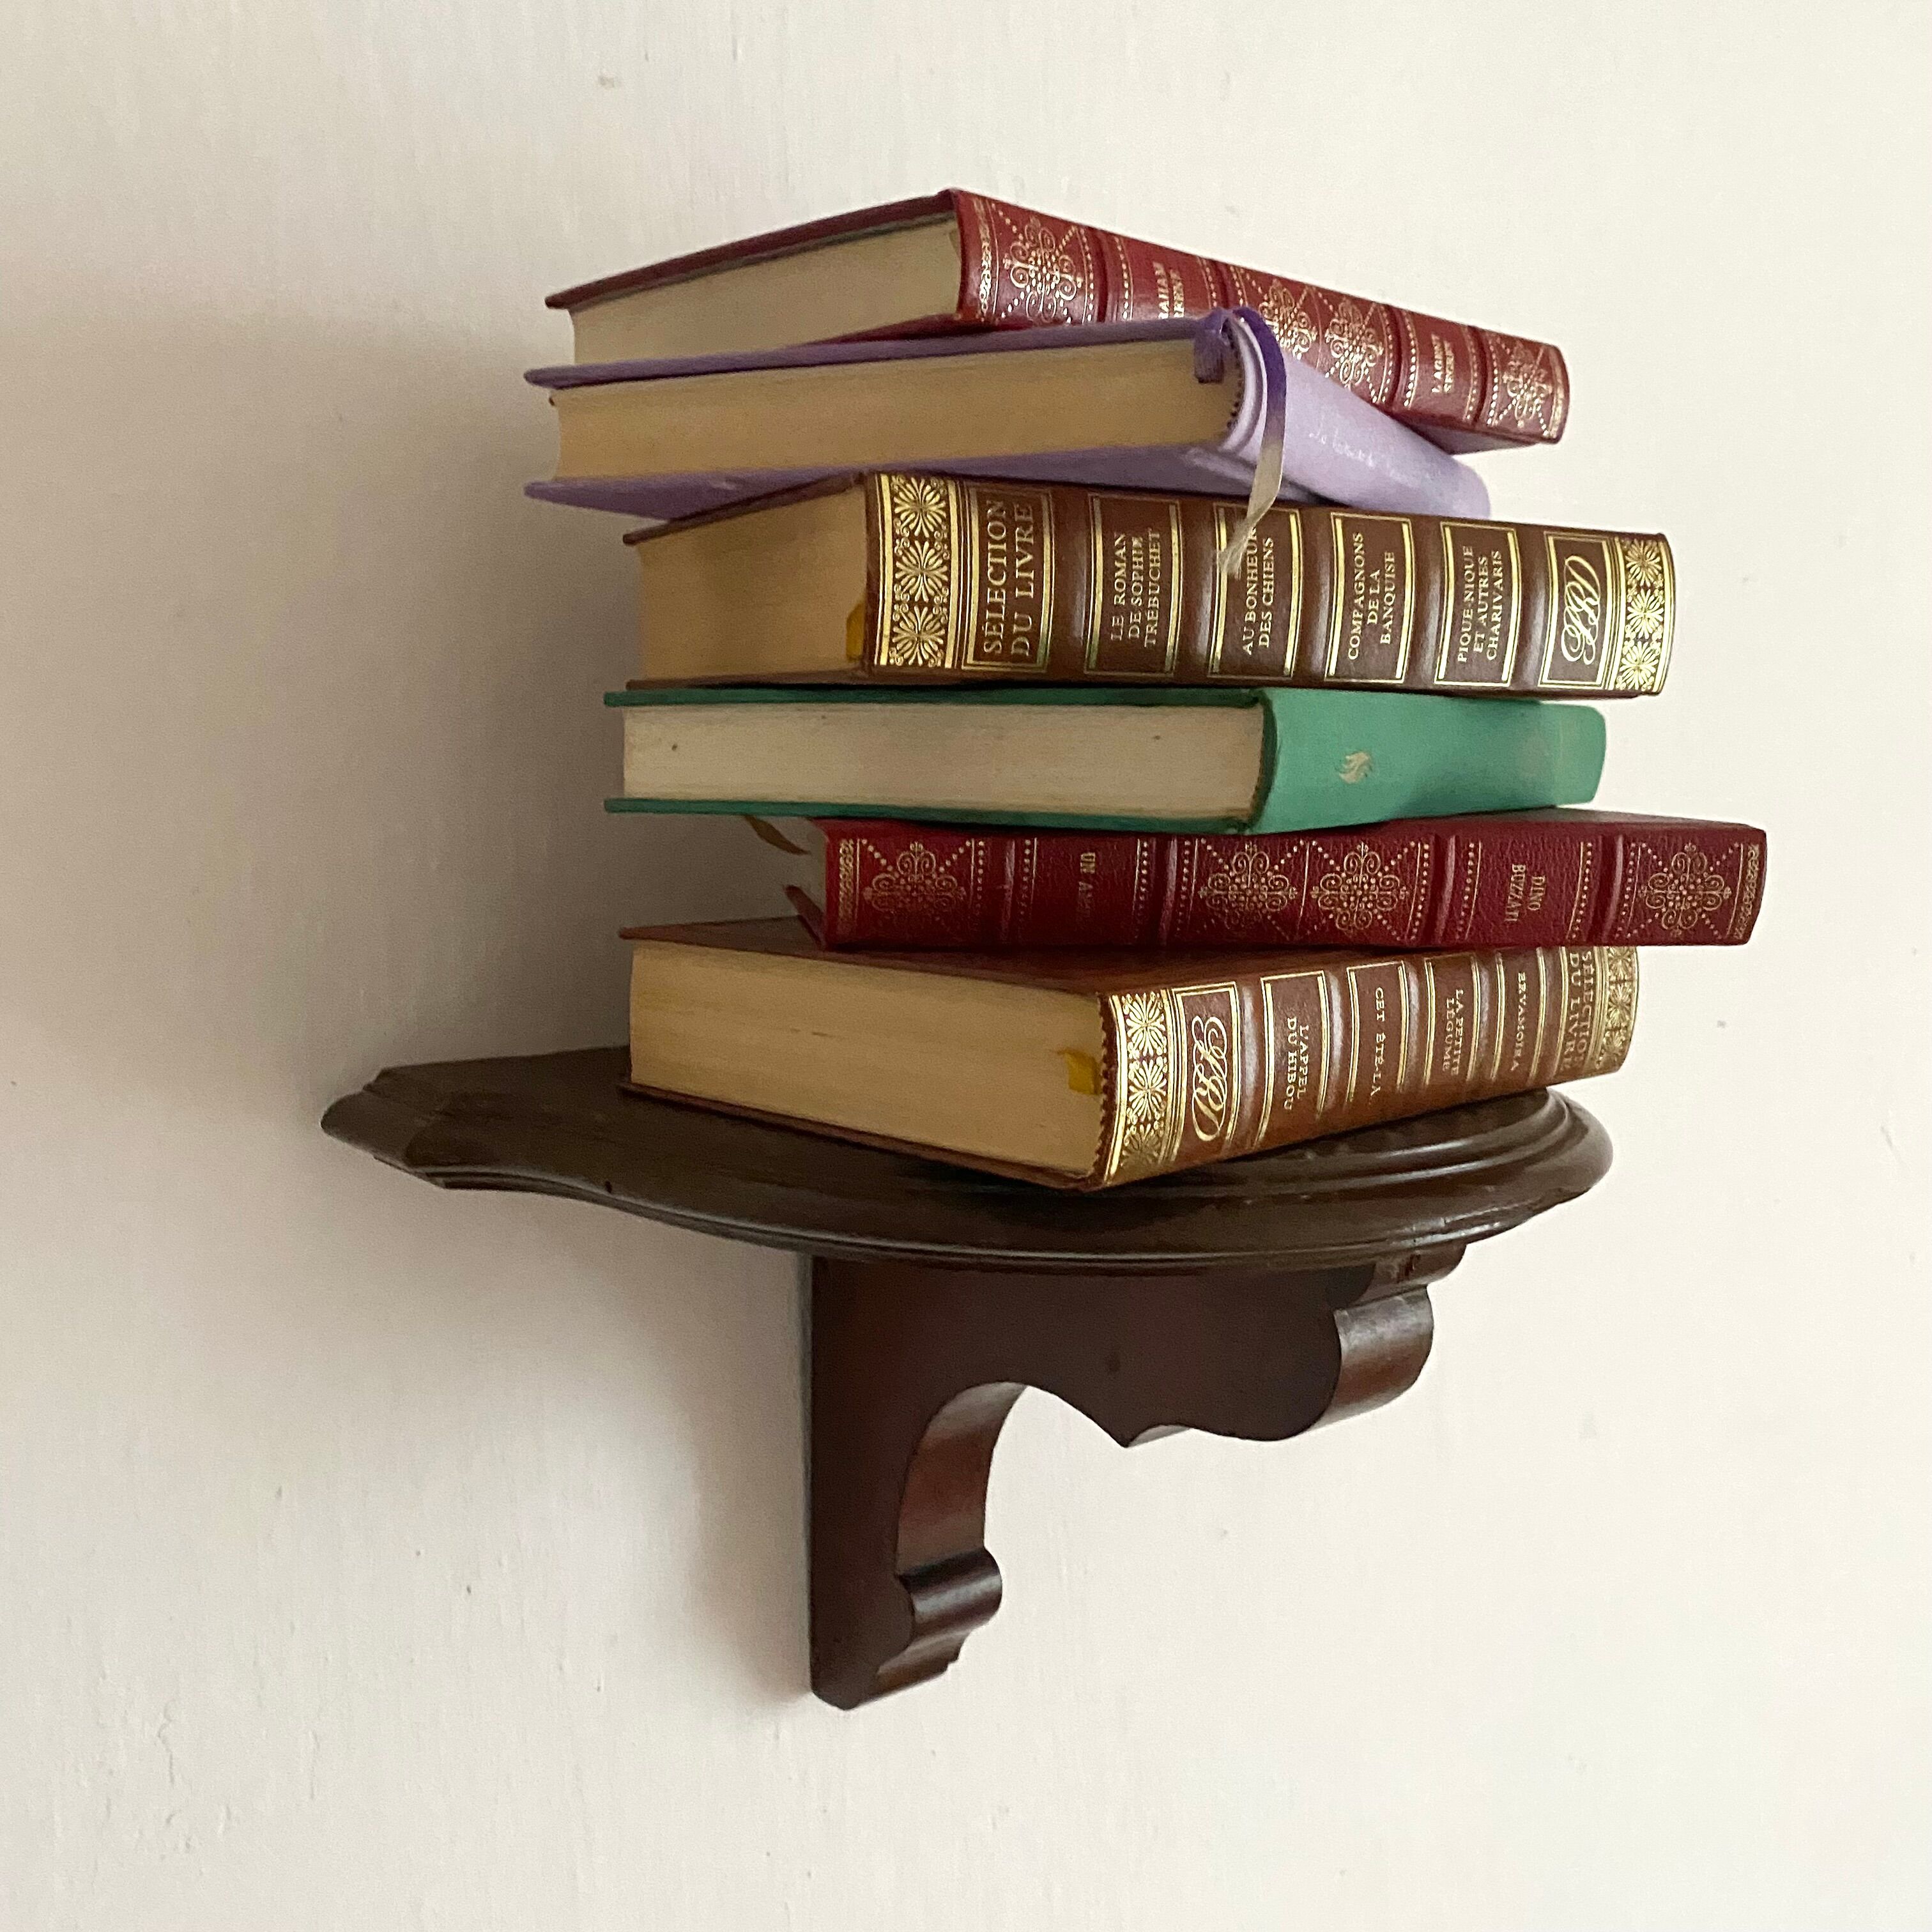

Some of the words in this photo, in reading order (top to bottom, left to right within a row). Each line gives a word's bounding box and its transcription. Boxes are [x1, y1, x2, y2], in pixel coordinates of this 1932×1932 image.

[1013, 503, 1034, 598] LIVRE
[1114, 531, 1126, 605] ROMAN
[1130, 537, 1144, 606] SOPHIE
[1262, 537, 1274, 606] CHIENS
[982, 500, 1007, 654] SÉLECTION
[1348, 532, 1365, 660] COMPAGNONS
[1370, 569, 1380, 594] LA
[1380, 551, 1395, 645] BANQUISE
[1477, 556, 1489, 626] AUTRES
[1111, 615, 1124, 640] LE
[1128, 610, 1142, 639] DE
[1259, 611, 1273, 648] DES
[1367, 599, 1379, 625] DE
[1487, 550, 1503, 661] CHARIVARIS
[1011, 611, 1032, 656] DU
[1243, 626, 1255, 656] AU
[1473, 631, 1485, 653] ET
[1505, 864, 1526, 922] BUZZATI
[1528, 875, 1545, 910] DINO
[1570, 953, 1581, 986] DU
[1375, 987, 1384, 1022] CET
[1455, 989, 1464, 1013] LA
[1287, 1017, 1298, 1045] DU
[1450, 1016, 1464, 1075] PETITE
[1284, 1051, 1297, 1110] HIBOU
[1297, 1025, 1309, 1099] L'APPEL
